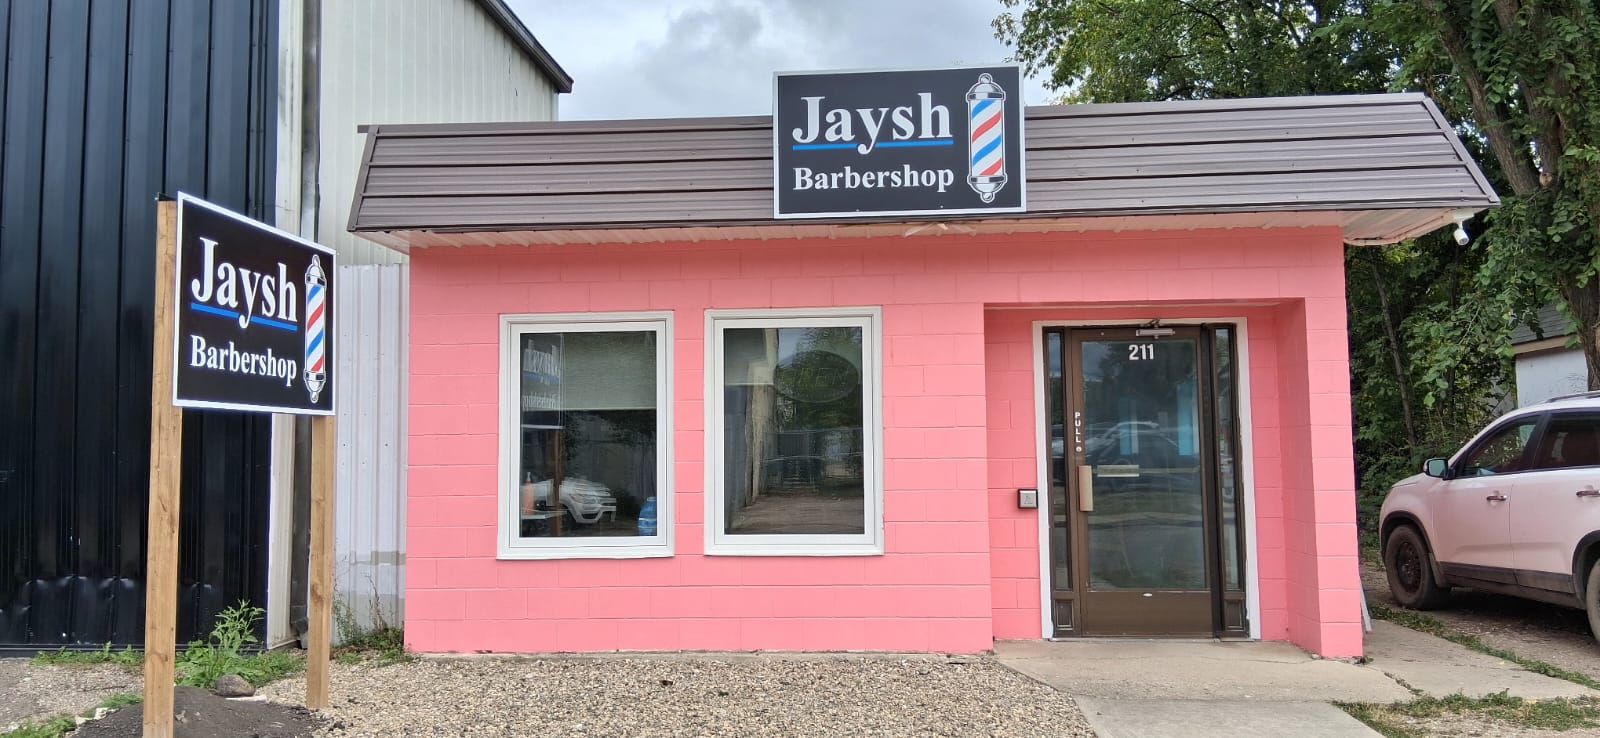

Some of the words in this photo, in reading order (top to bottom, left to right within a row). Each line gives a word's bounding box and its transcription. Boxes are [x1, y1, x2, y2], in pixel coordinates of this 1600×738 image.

[792, 92, 953, 155] Jaysh
[793, 164, 954, 193] Barbershop
[191, 236, 298, 329] Jaysh
[190, 334, 297, 387] Barbershop
[1128, 343, 1155, 361] 211
[1074, 411, 1082, 443] PULL
